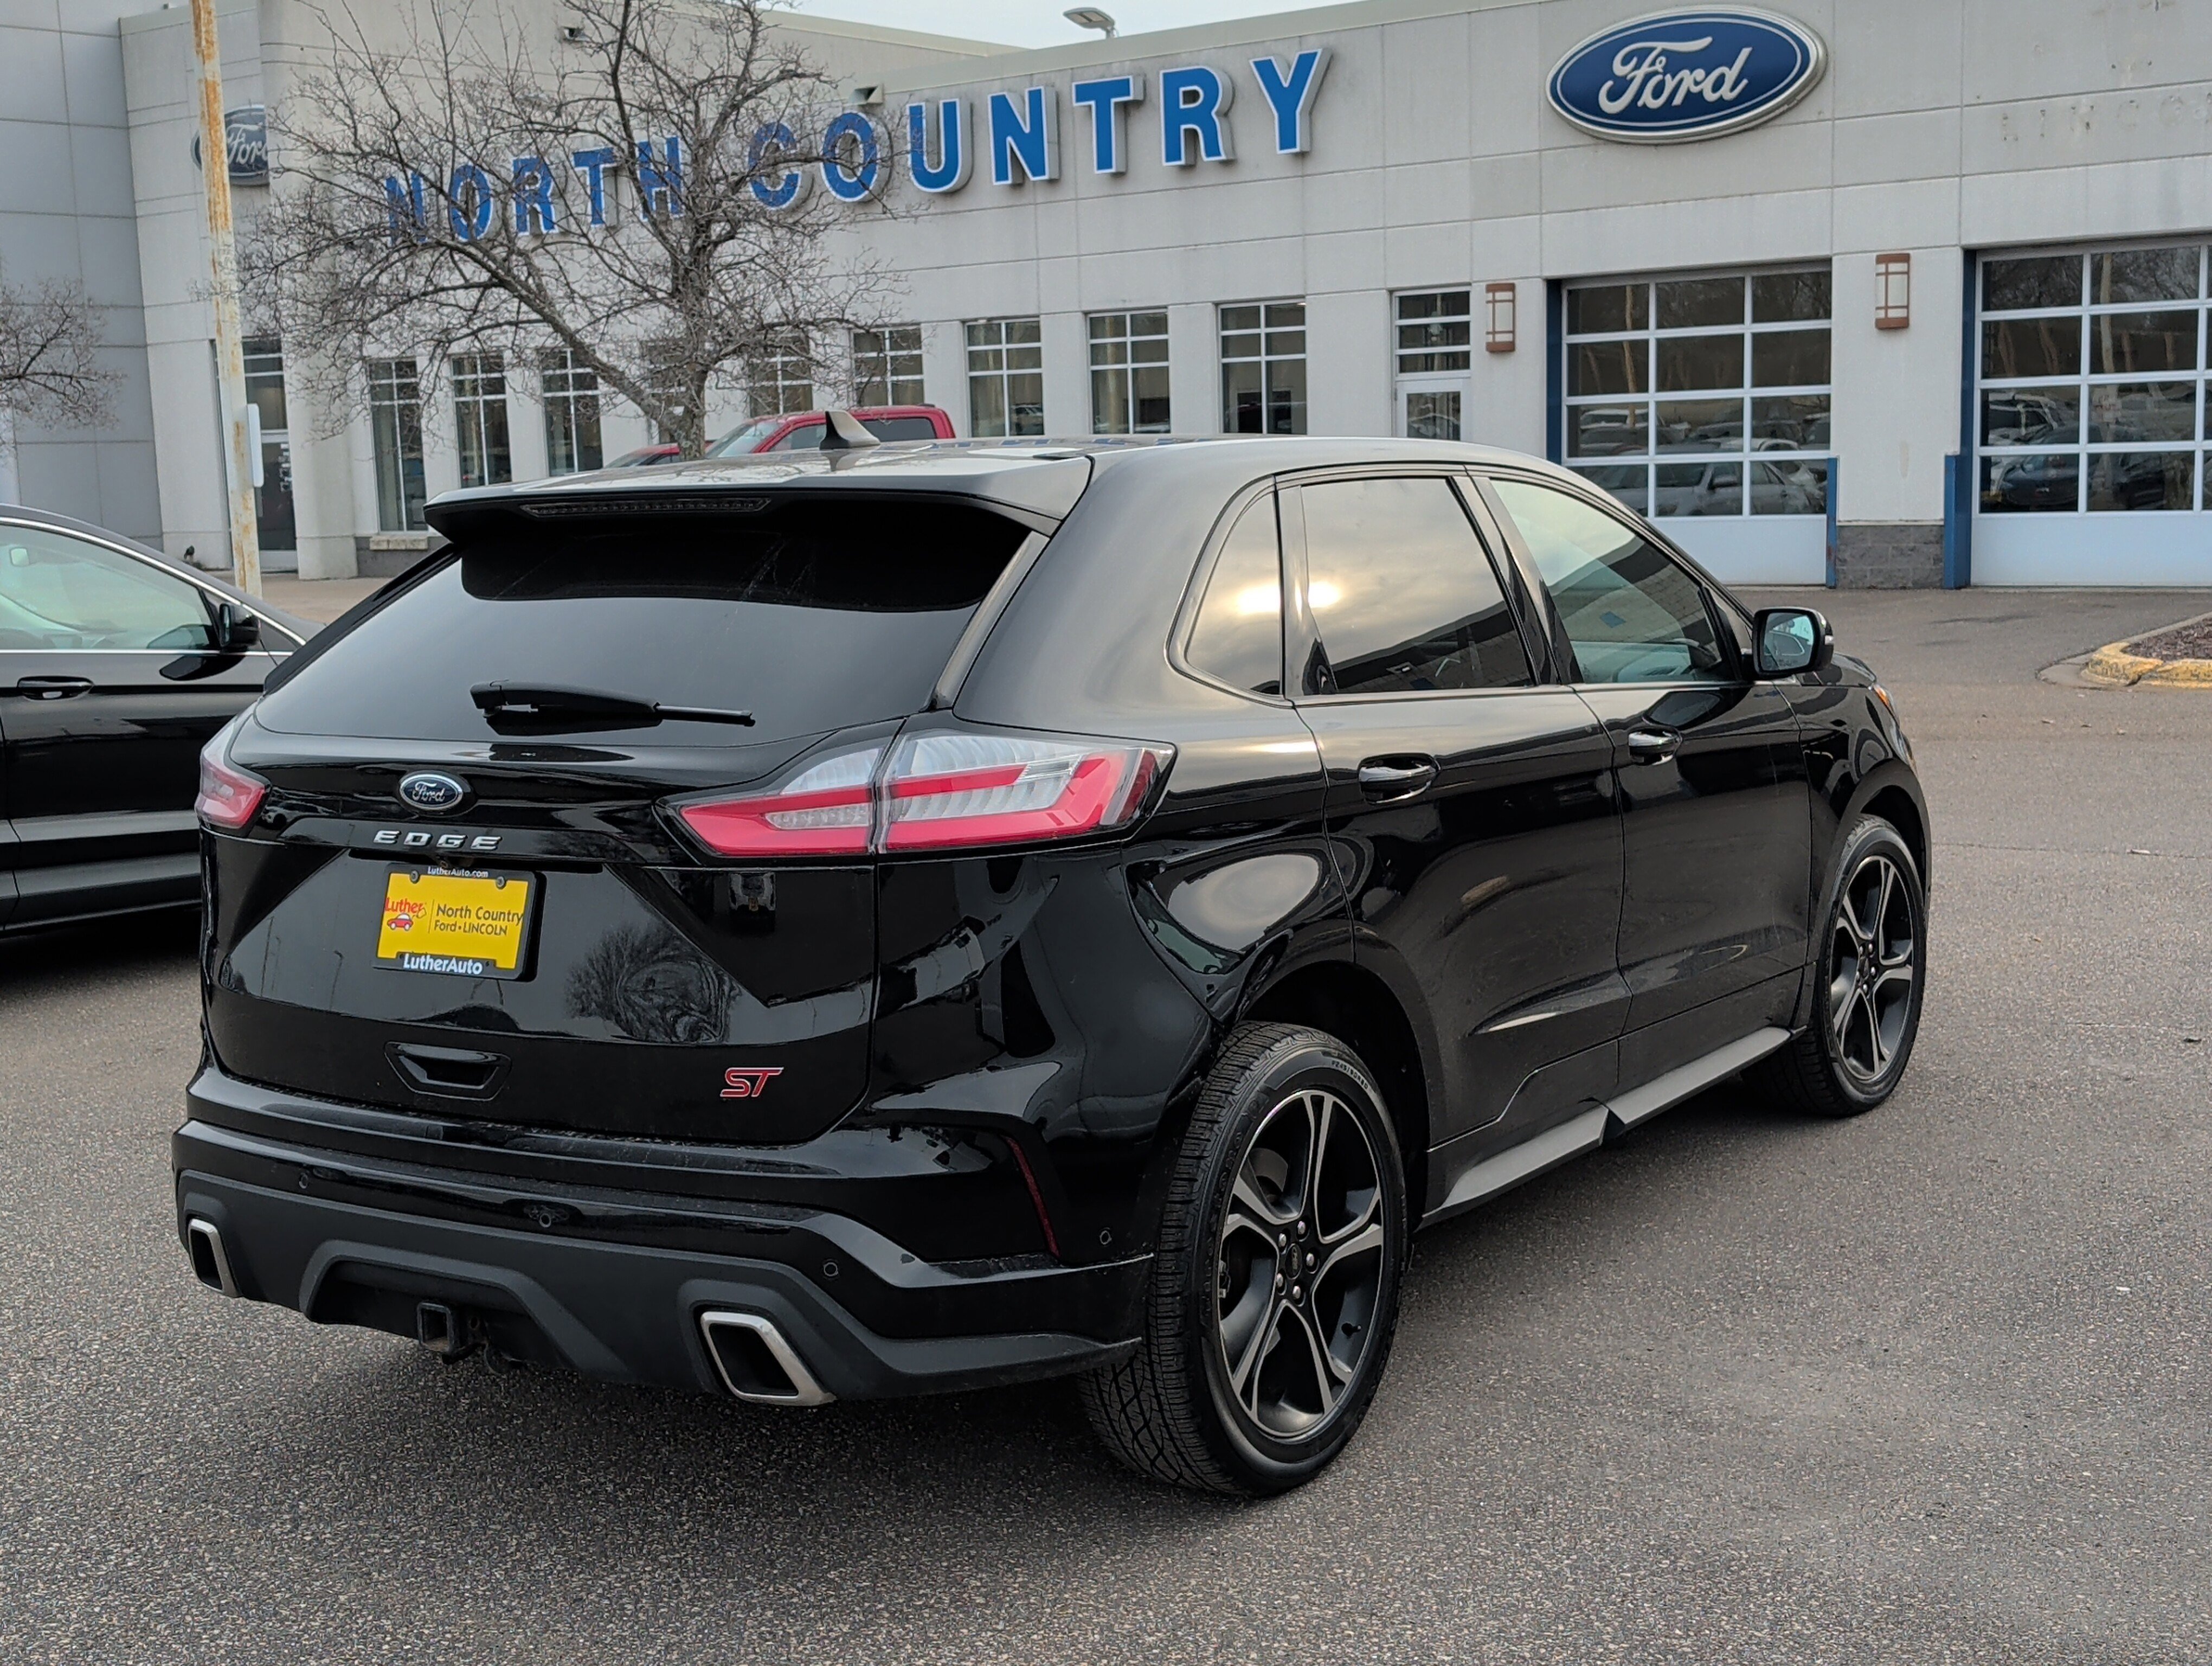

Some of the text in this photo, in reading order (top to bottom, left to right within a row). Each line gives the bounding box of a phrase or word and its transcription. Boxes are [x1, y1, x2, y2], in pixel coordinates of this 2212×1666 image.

[1598, 36, 1752, 114] Ford
[385, 49, 1323, 246] NORTH COUNTRY
[413, 781, 445, 802] Ford
[374, 830, 502, 850] EDGE
[427, 866, 488, 878] LutherAuto.com
[385, 897, 423, 913] Luther
[436, 904, 523, 926] North Country
[403, 953, 483, 975] LutherAuto
[719, 1067, 784, 1097] ST
